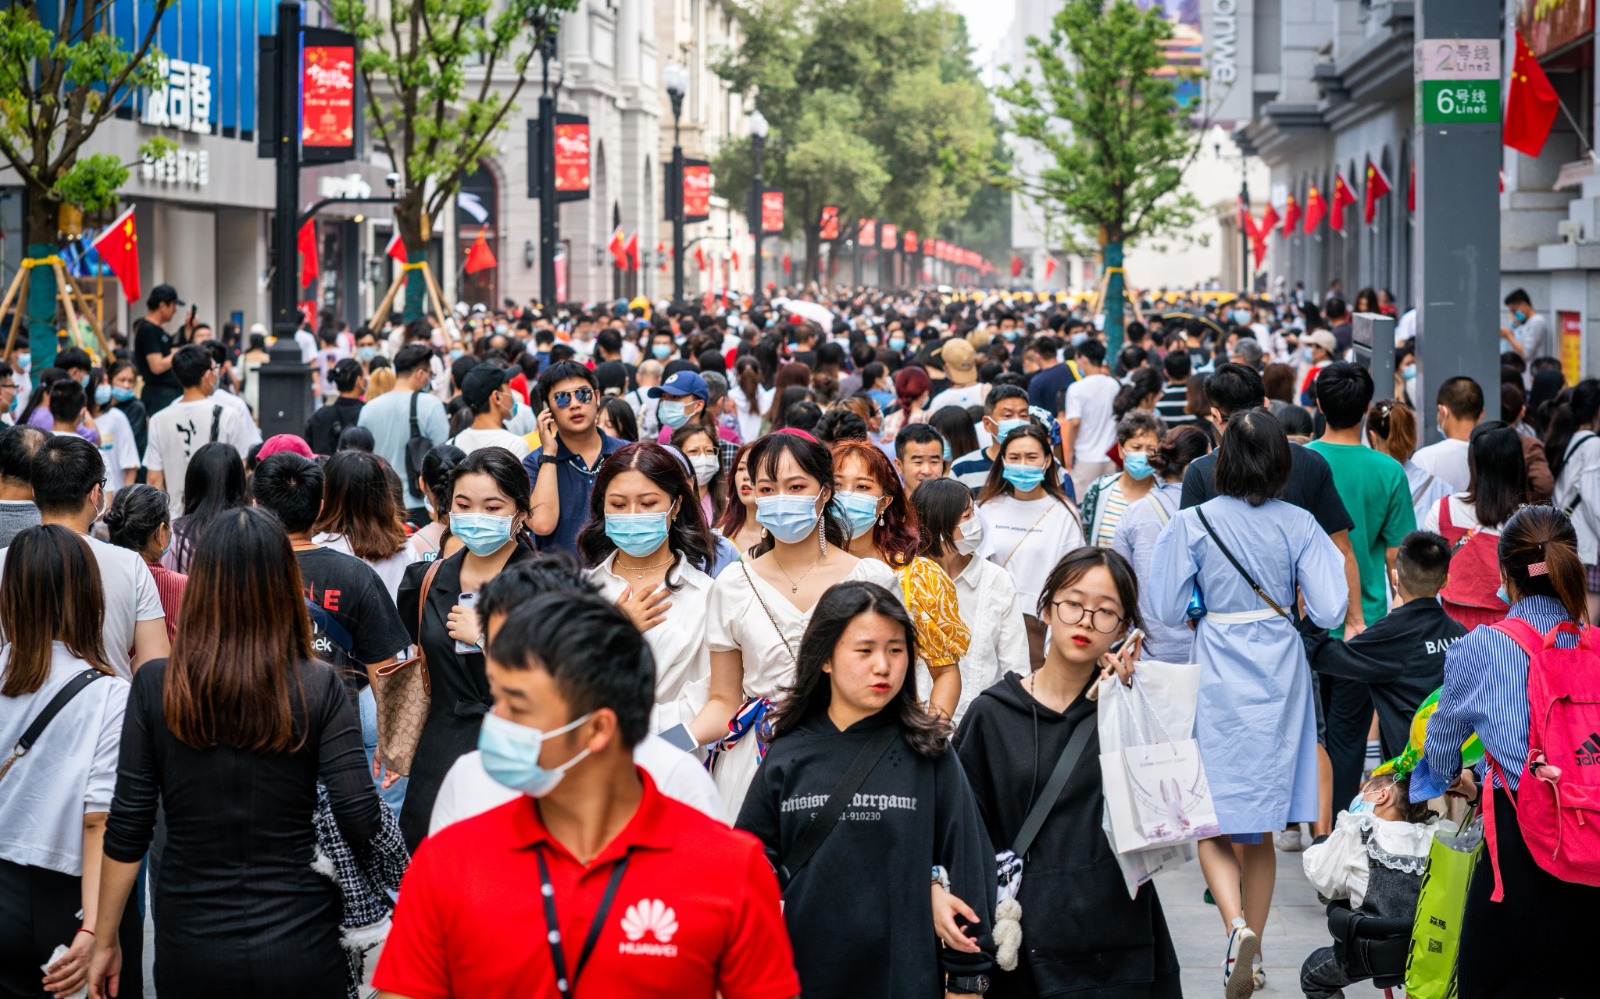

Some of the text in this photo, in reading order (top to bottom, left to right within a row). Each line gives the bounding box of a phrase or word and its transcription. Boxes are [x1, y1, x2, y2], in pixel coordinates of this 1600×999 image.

[1457, 63, 1490, 71] Line2
[1456, 105, 1487, 114] Line6
[618, 942, 678, 957] HUAWEI
